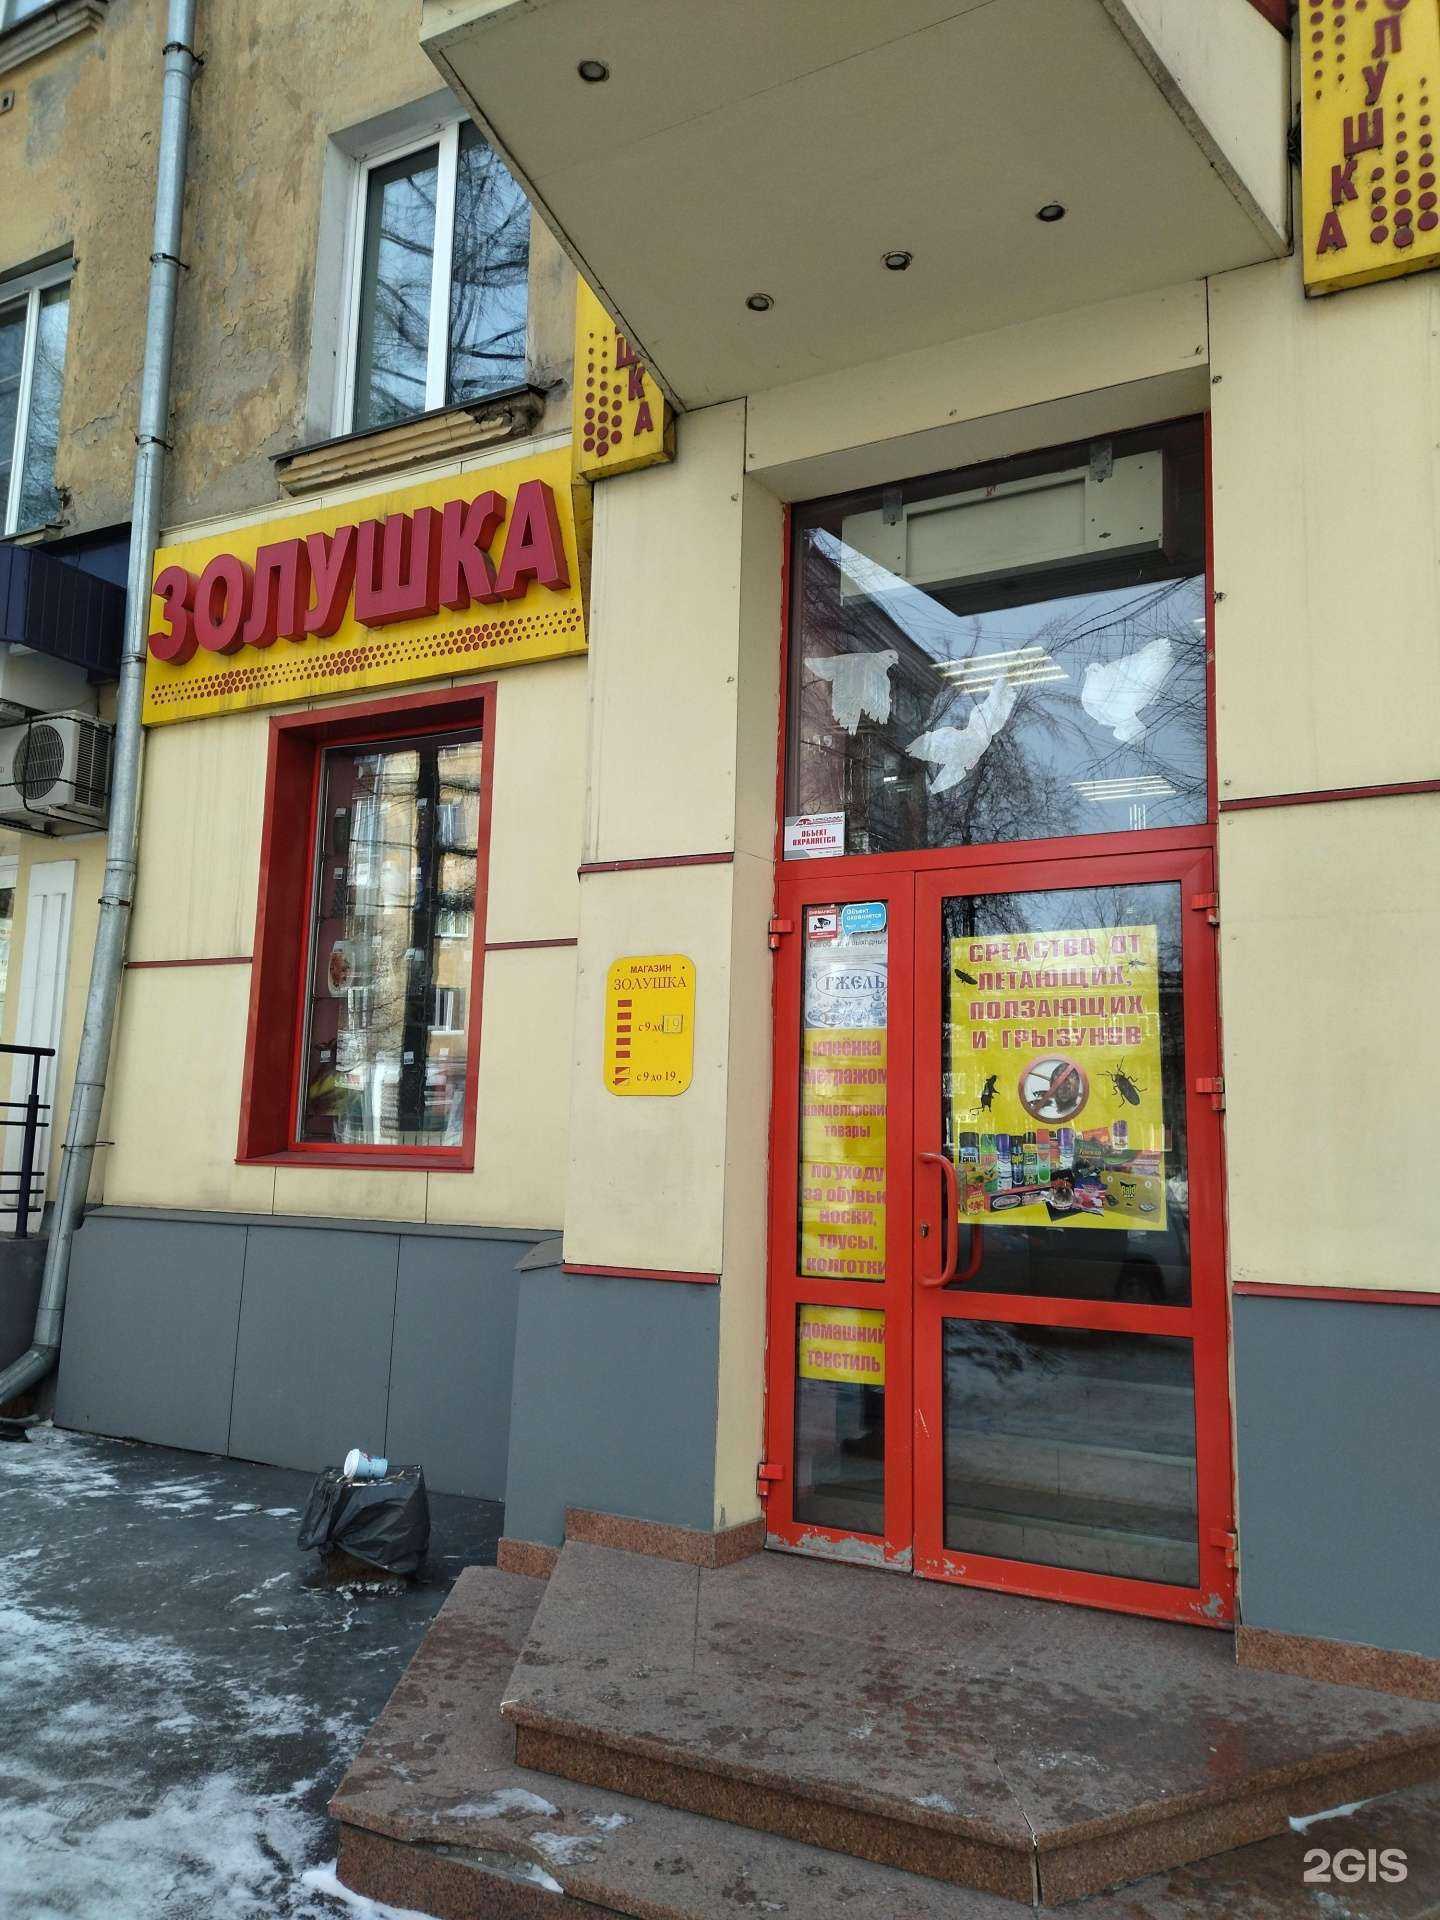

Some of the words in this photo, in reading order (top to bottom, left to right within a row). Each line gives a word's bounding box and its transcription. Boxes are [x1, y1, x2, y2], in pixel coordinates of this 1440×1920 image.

[1316, 0, 1410, 254] ЛУШКА
[148, 479, 571, 666] ЗОЛУШКА
[969, 937, 1096, 963] СРЕДСТВО
[1111, 934, 1141, 954] ОТ
[630, 965, 671, 973] МАГАЗИН
[977, 965, 1133, 990] ЛЕТАЮЩИХ,
[614, 976, 687, 990] ЗОЛУШКА
[970, 994, 1144, 1020] ПОЛЗАЮЩИХ
[645, 1021, 651, 1031] 9
[972, 1030, 987, 1049] И
[1002, 1026, 1143, 1049] ГРЫЗУНОВ
[643, 1071, 649, 1080] 9
[665, 1071, 676, 1080] 19
